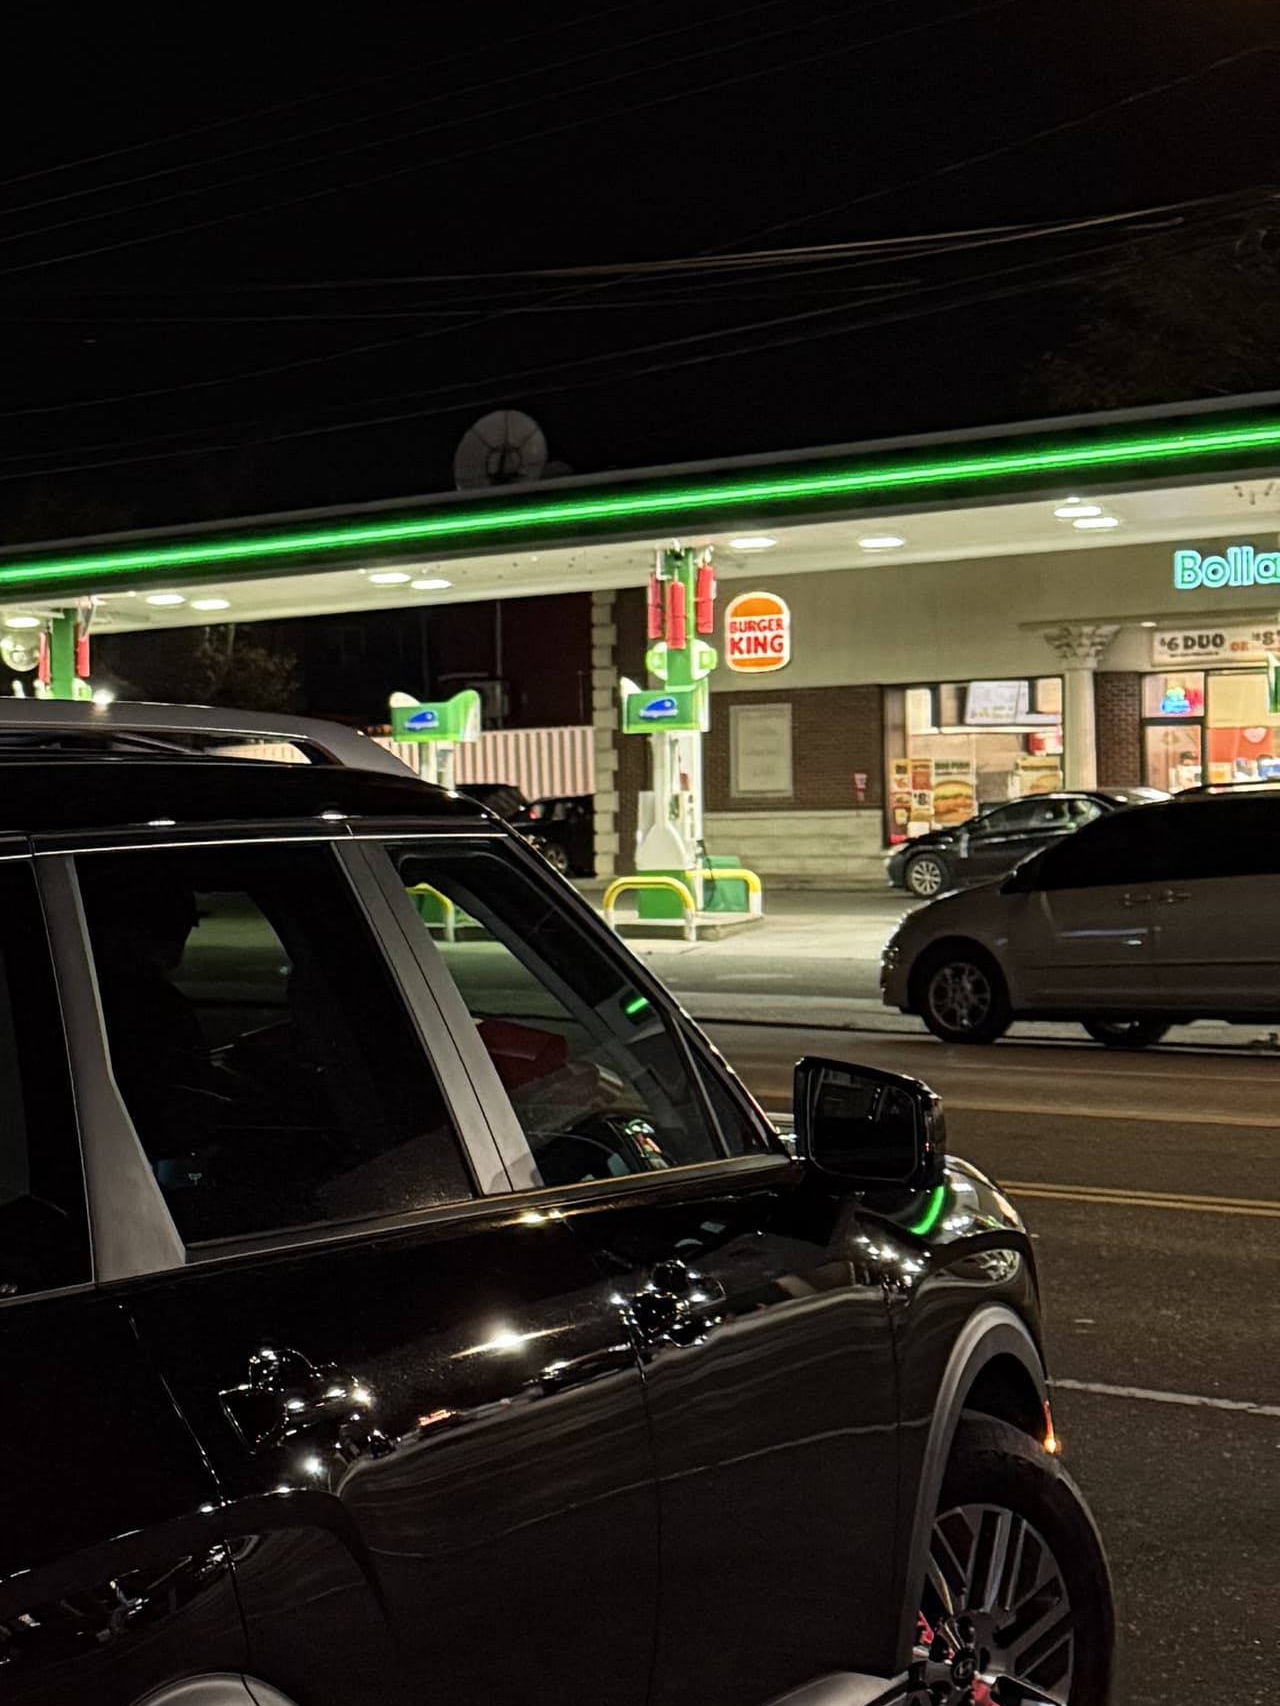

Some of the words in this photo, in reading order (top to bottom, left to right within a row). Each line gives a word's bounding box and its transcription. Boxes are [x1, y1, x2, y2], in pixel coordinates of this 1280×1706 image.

[729, 618, 784, 633] BURGER
[730, 635, 784, 655] KING
[1183, 633, 1225, 650] DUO
